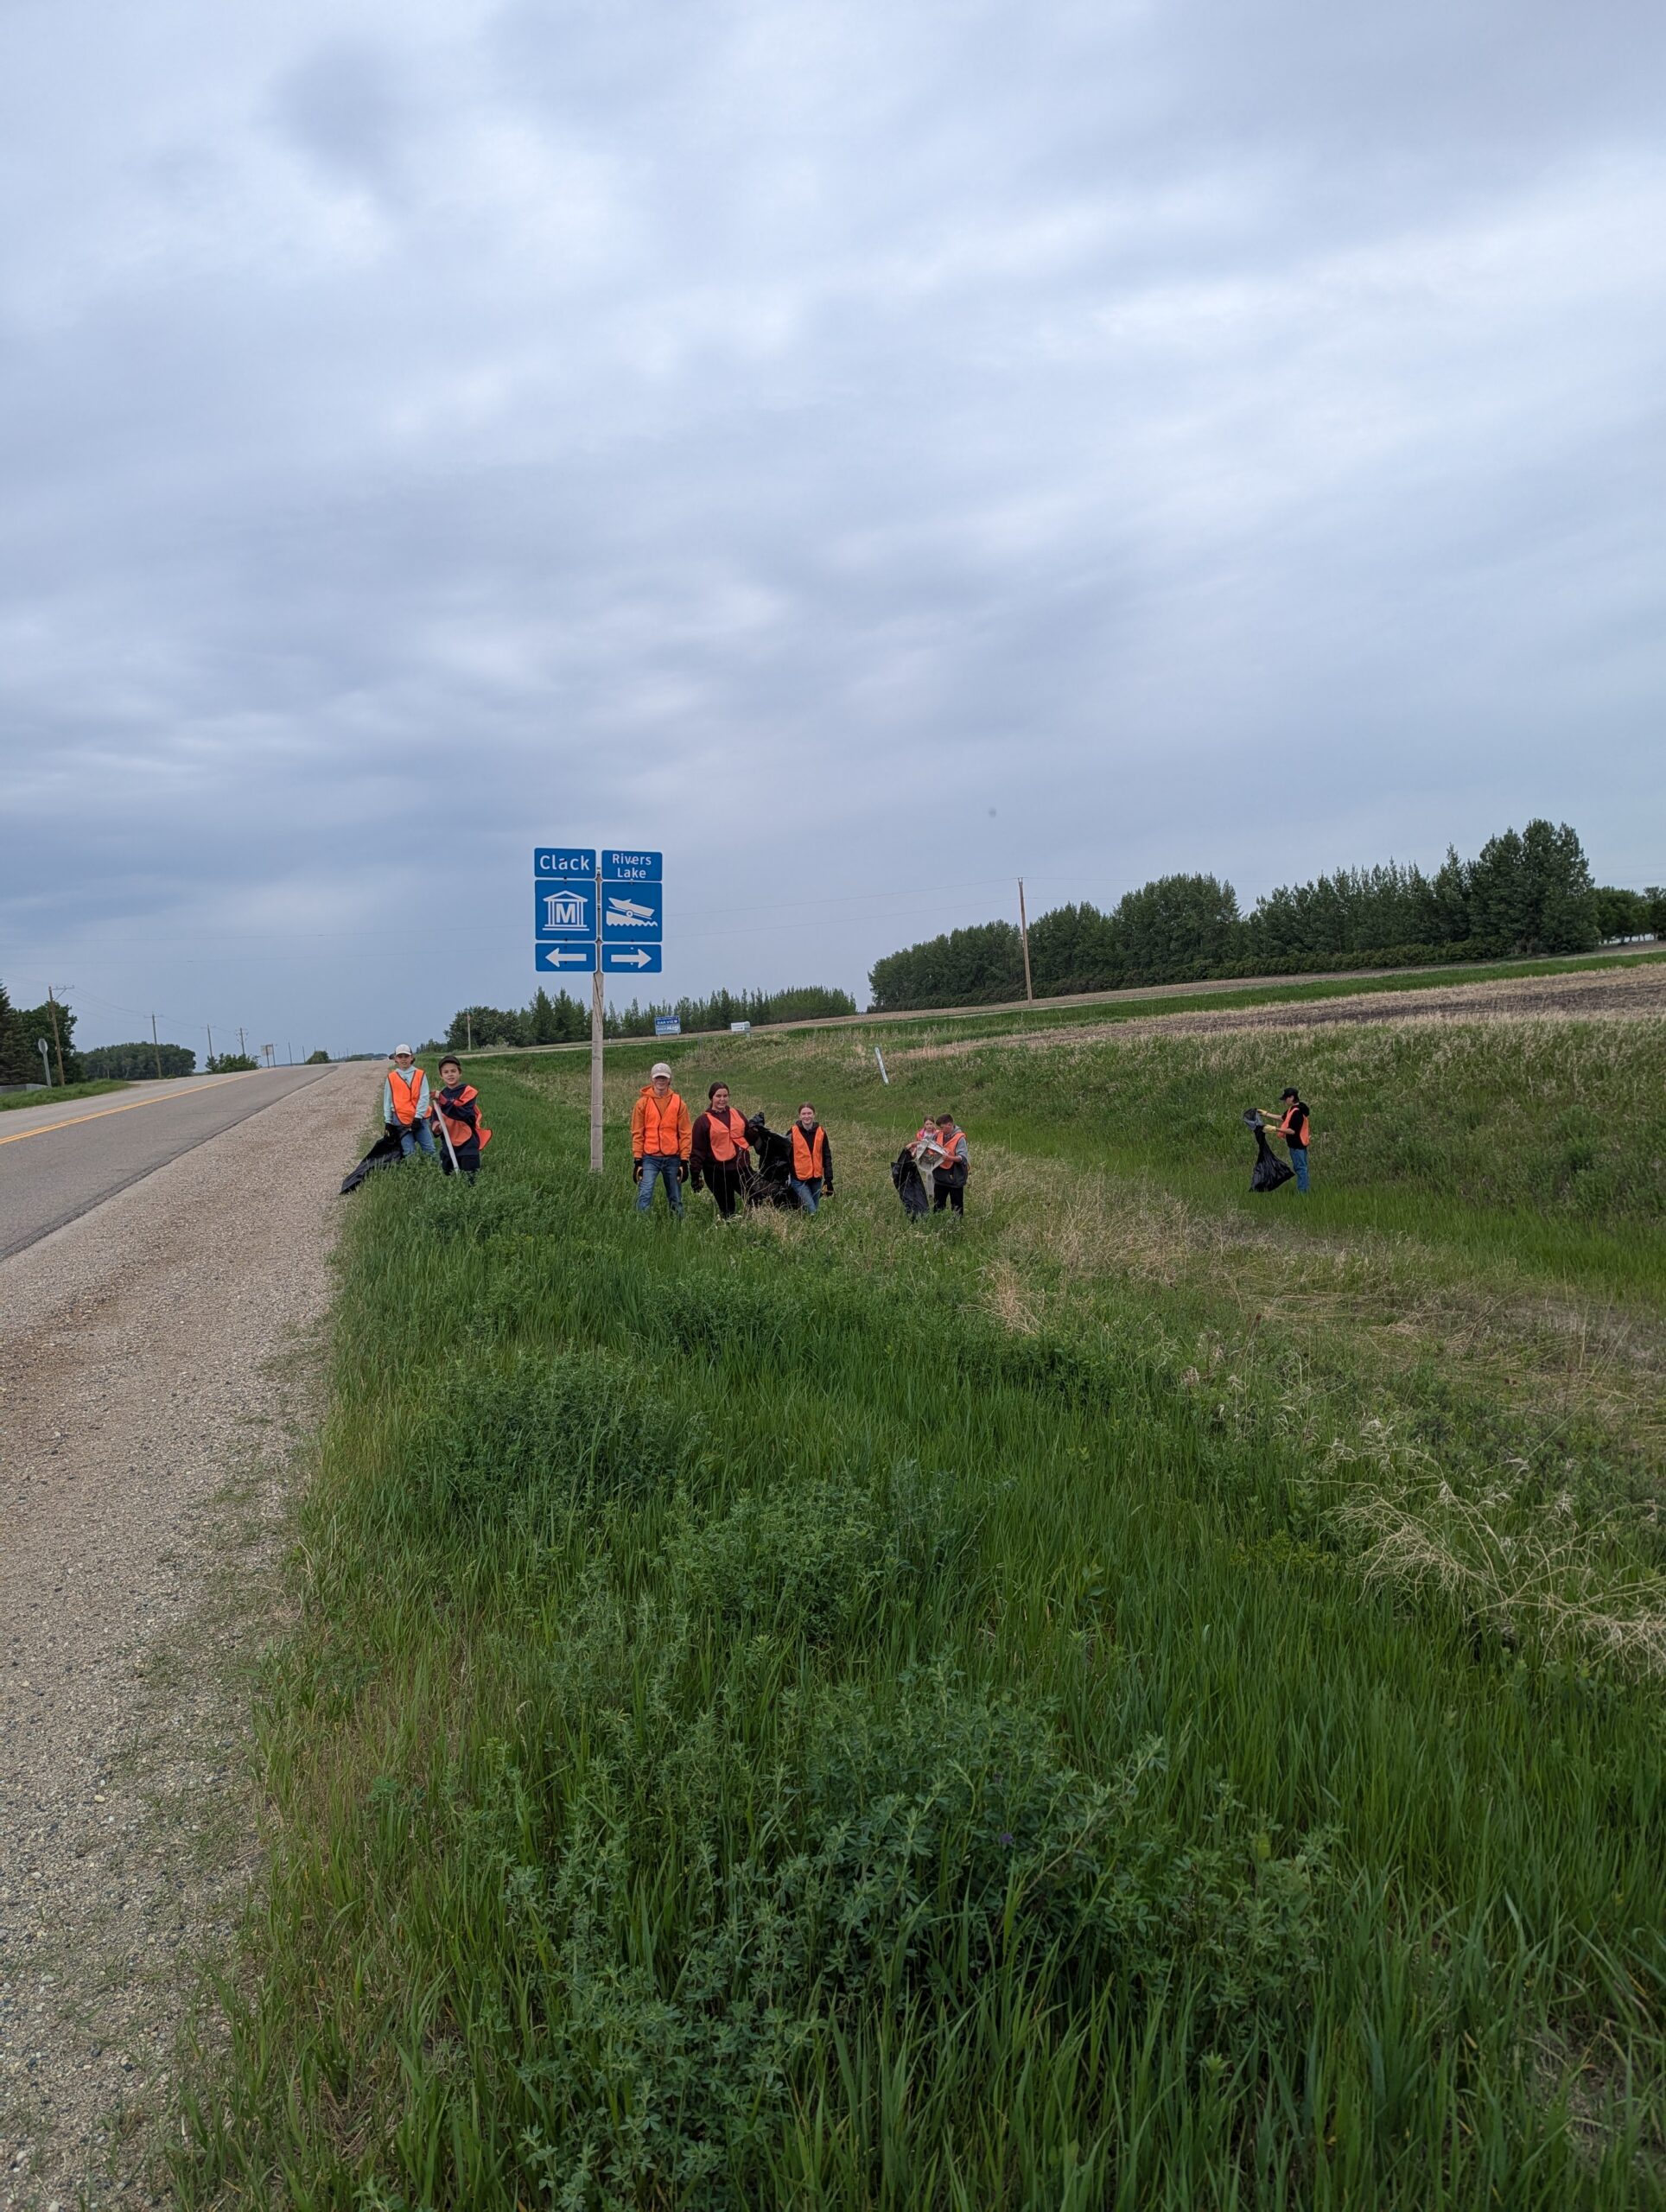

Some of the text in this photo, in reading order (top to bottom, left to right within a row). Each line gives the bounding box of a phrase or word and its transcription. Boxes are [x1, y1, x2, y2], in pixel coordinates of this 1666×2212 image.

[540, 855, 589, 871] Clack
[612, 854, 652, 866] Rivers
[617, 868, 646, 879] Lake
[556, 903, 575, 923] M
